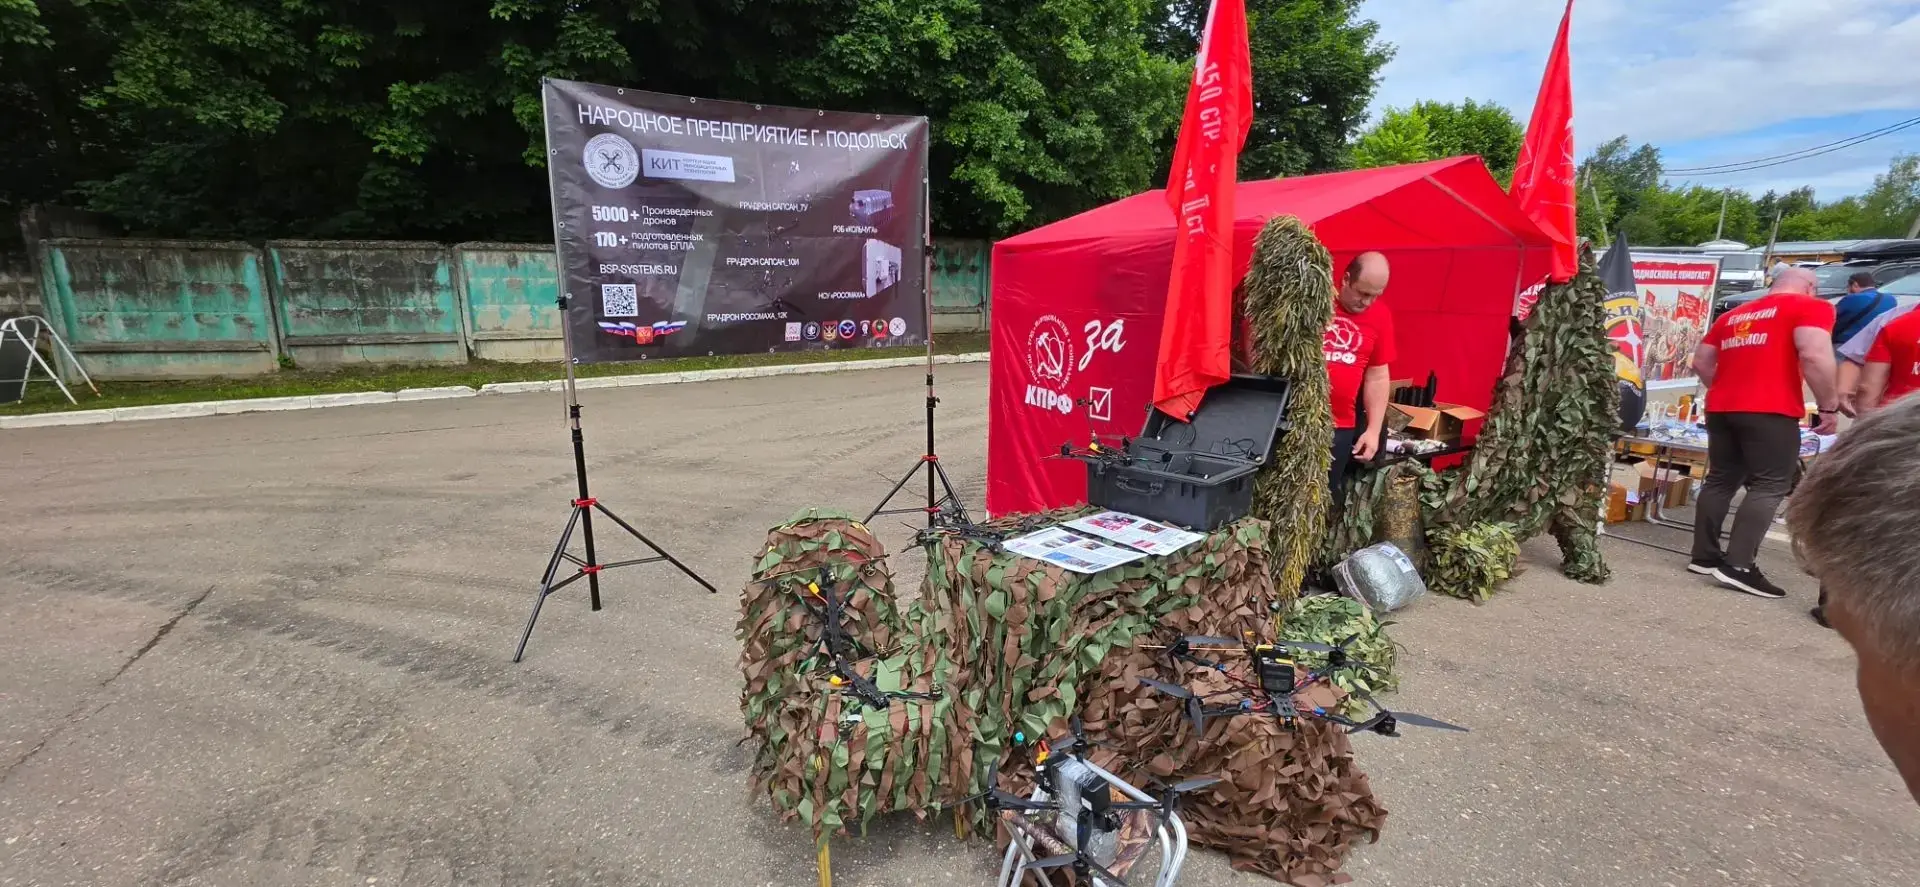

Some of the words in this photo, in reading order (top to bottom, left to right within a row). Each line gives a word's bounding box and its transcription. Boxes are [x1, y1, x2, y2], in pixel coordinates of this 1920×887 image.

[578, 104, 681, 134] НАРОДНОЕ
[686, 118, 808, 146] ПРЕДПРИЯТИЕ
[826, 131, 908, 151] ПОДОЛЬСК
[651, 157, 681, 170] КИТ
[641, 205, 713, 217] Произведенных
[642, 217, 677, 227] дронов
[631, 232, 704, 242] подготовленных
[632, 242, 668, 250] пилотов
[670, 241, 695, 251] БПЛА
[600, 263, 678, 275] BSP-SYSTEMS.RU
[1025, 384, 1073, 414] КПРФ
